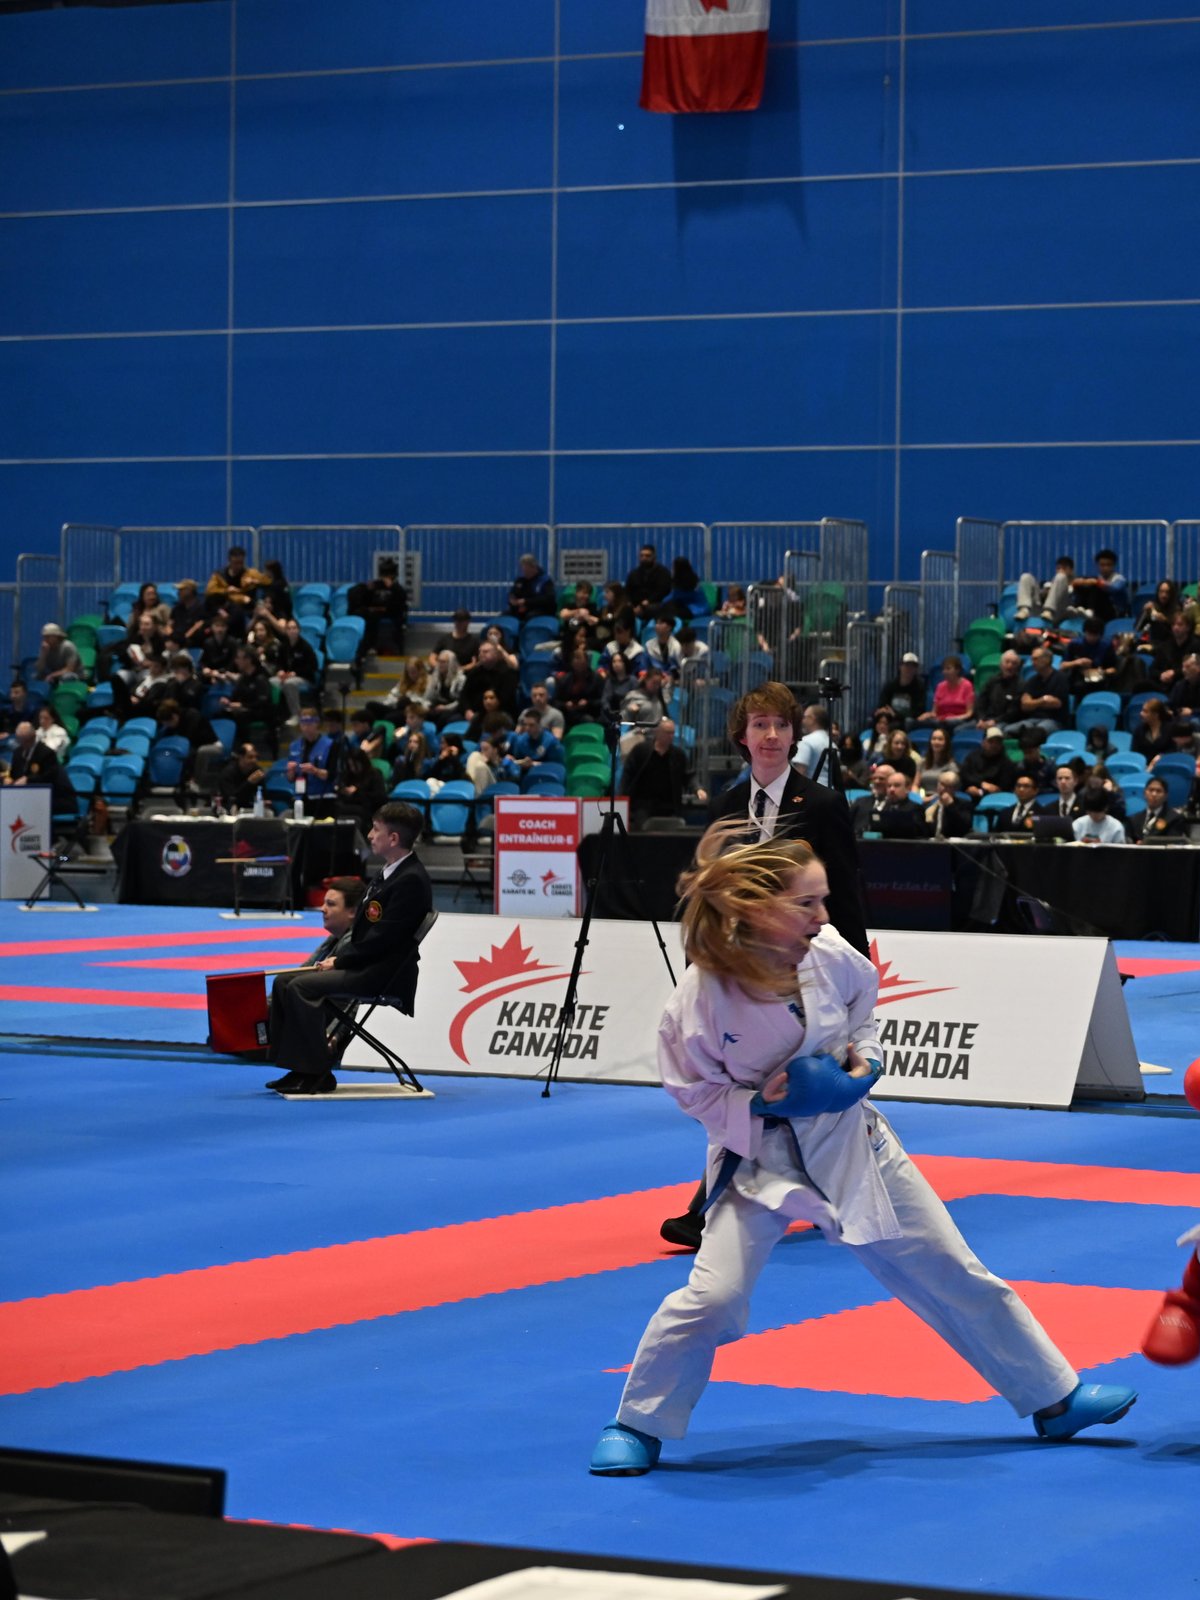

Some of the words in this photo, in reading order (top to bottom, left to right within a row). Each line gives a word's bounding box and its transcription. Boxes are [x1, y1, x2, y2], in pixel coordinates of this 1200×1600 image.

[519, 819, 556, 830] COACH
[875, 1019, 979, 1049] ARATE
[882, 1050, 970, 1080] NADA
